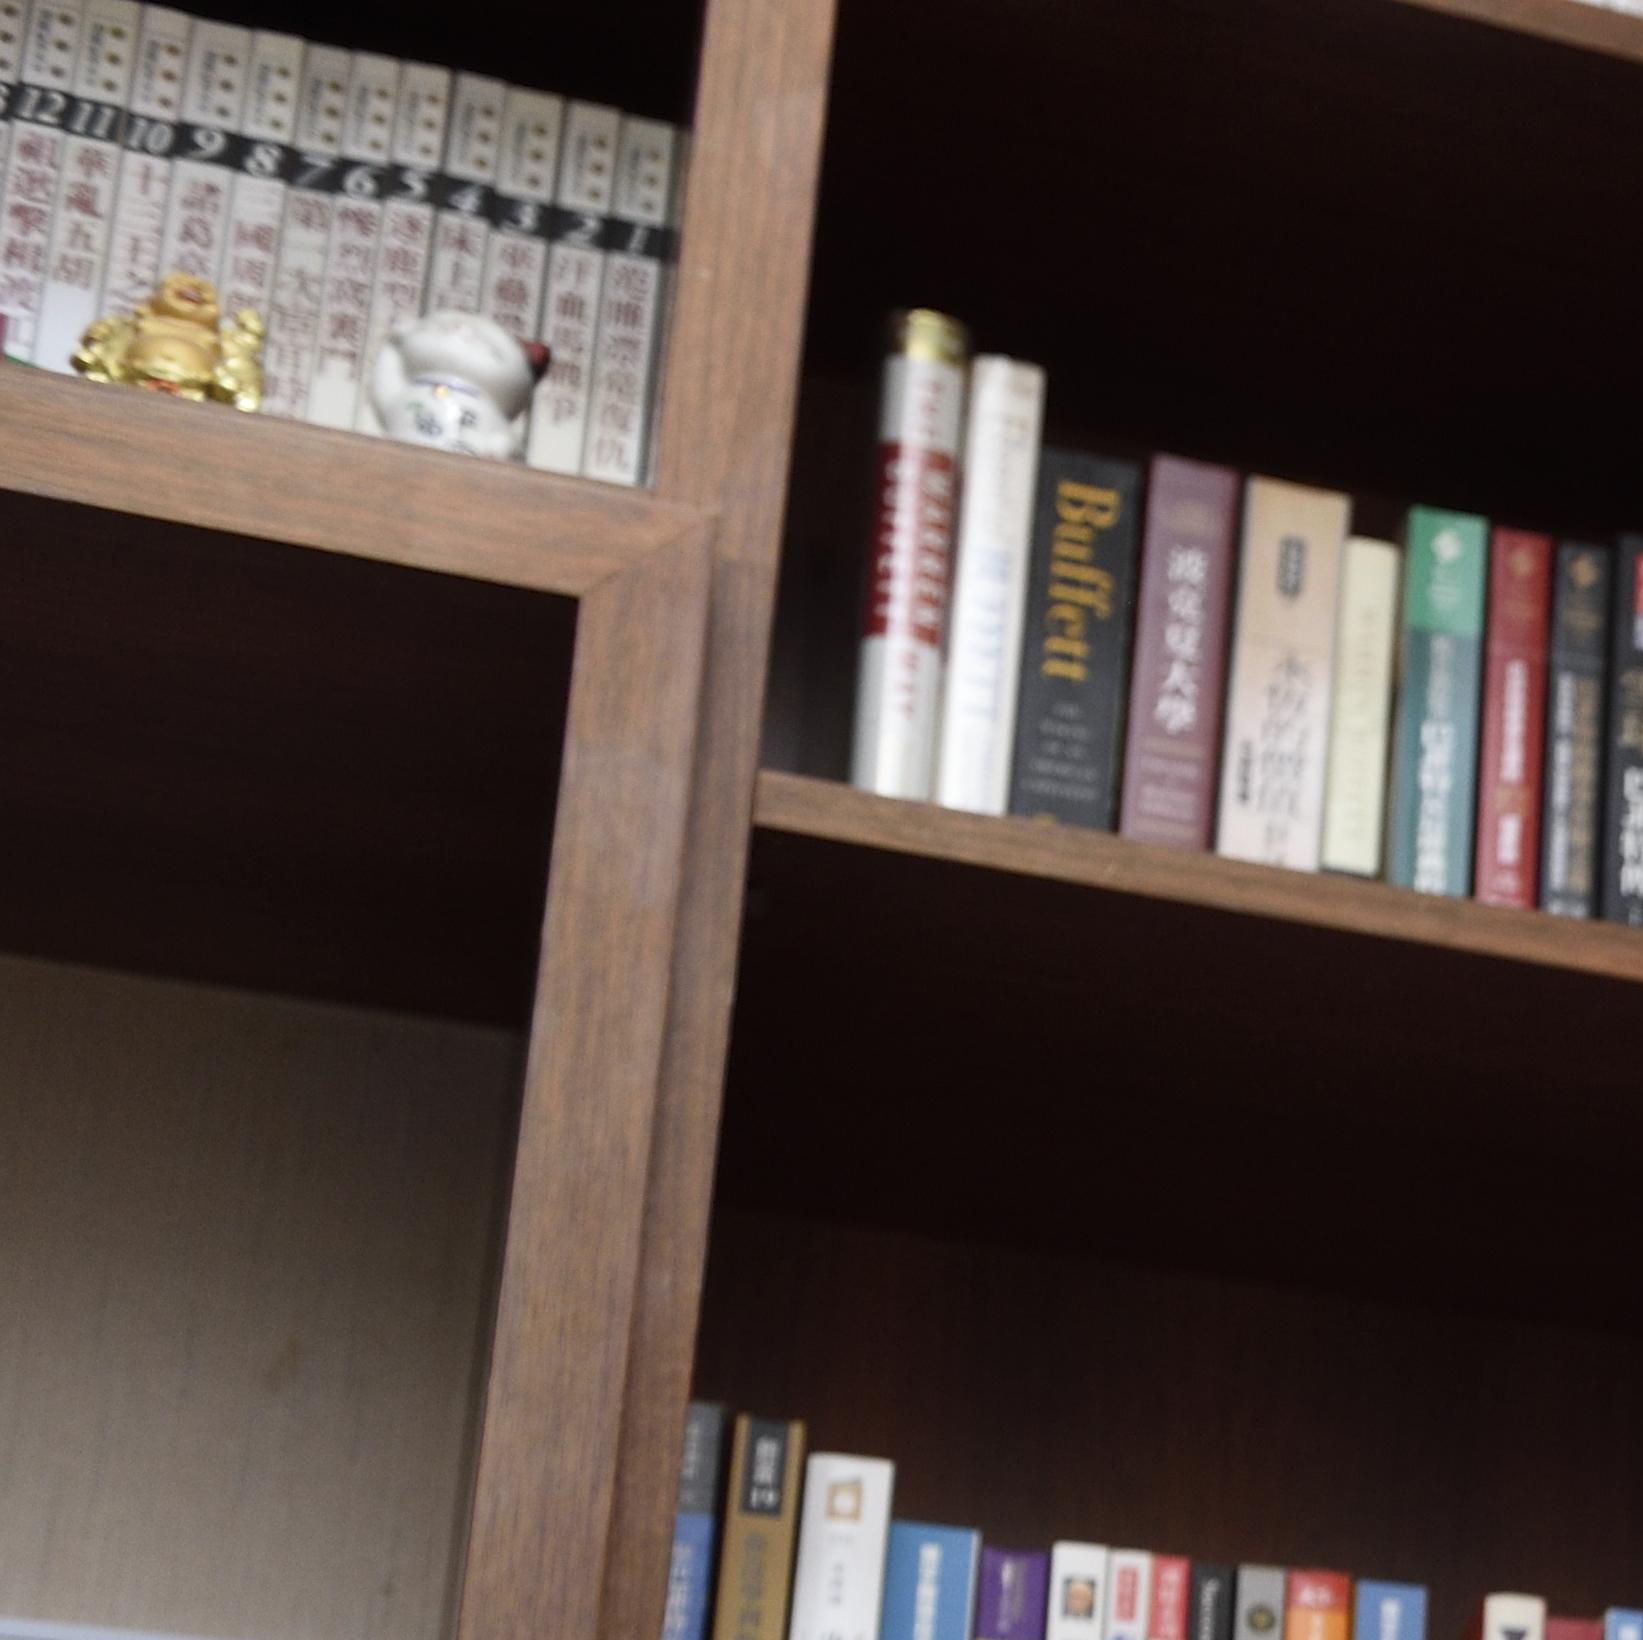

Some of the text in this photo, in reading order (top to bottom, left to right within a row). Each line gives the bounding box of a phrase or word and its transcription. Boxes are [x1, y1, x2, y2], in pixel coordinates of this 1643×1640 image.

[21, 85, 66, 120] 12
[72, 93, 118, 134] 11
[128, 112, 175, 156] 10
[193, 127, 228, 161] 9
[246, 141, 284, 176] 8
[299, 155, 337, 189] 7
[343, 165, 377, 199] 6
[400, 168, 433, 201] 5
[449, 184, 483, 217] 4
[507, 202, 539, 234] 3
[1042, 479, 1122, 684] Buffett
